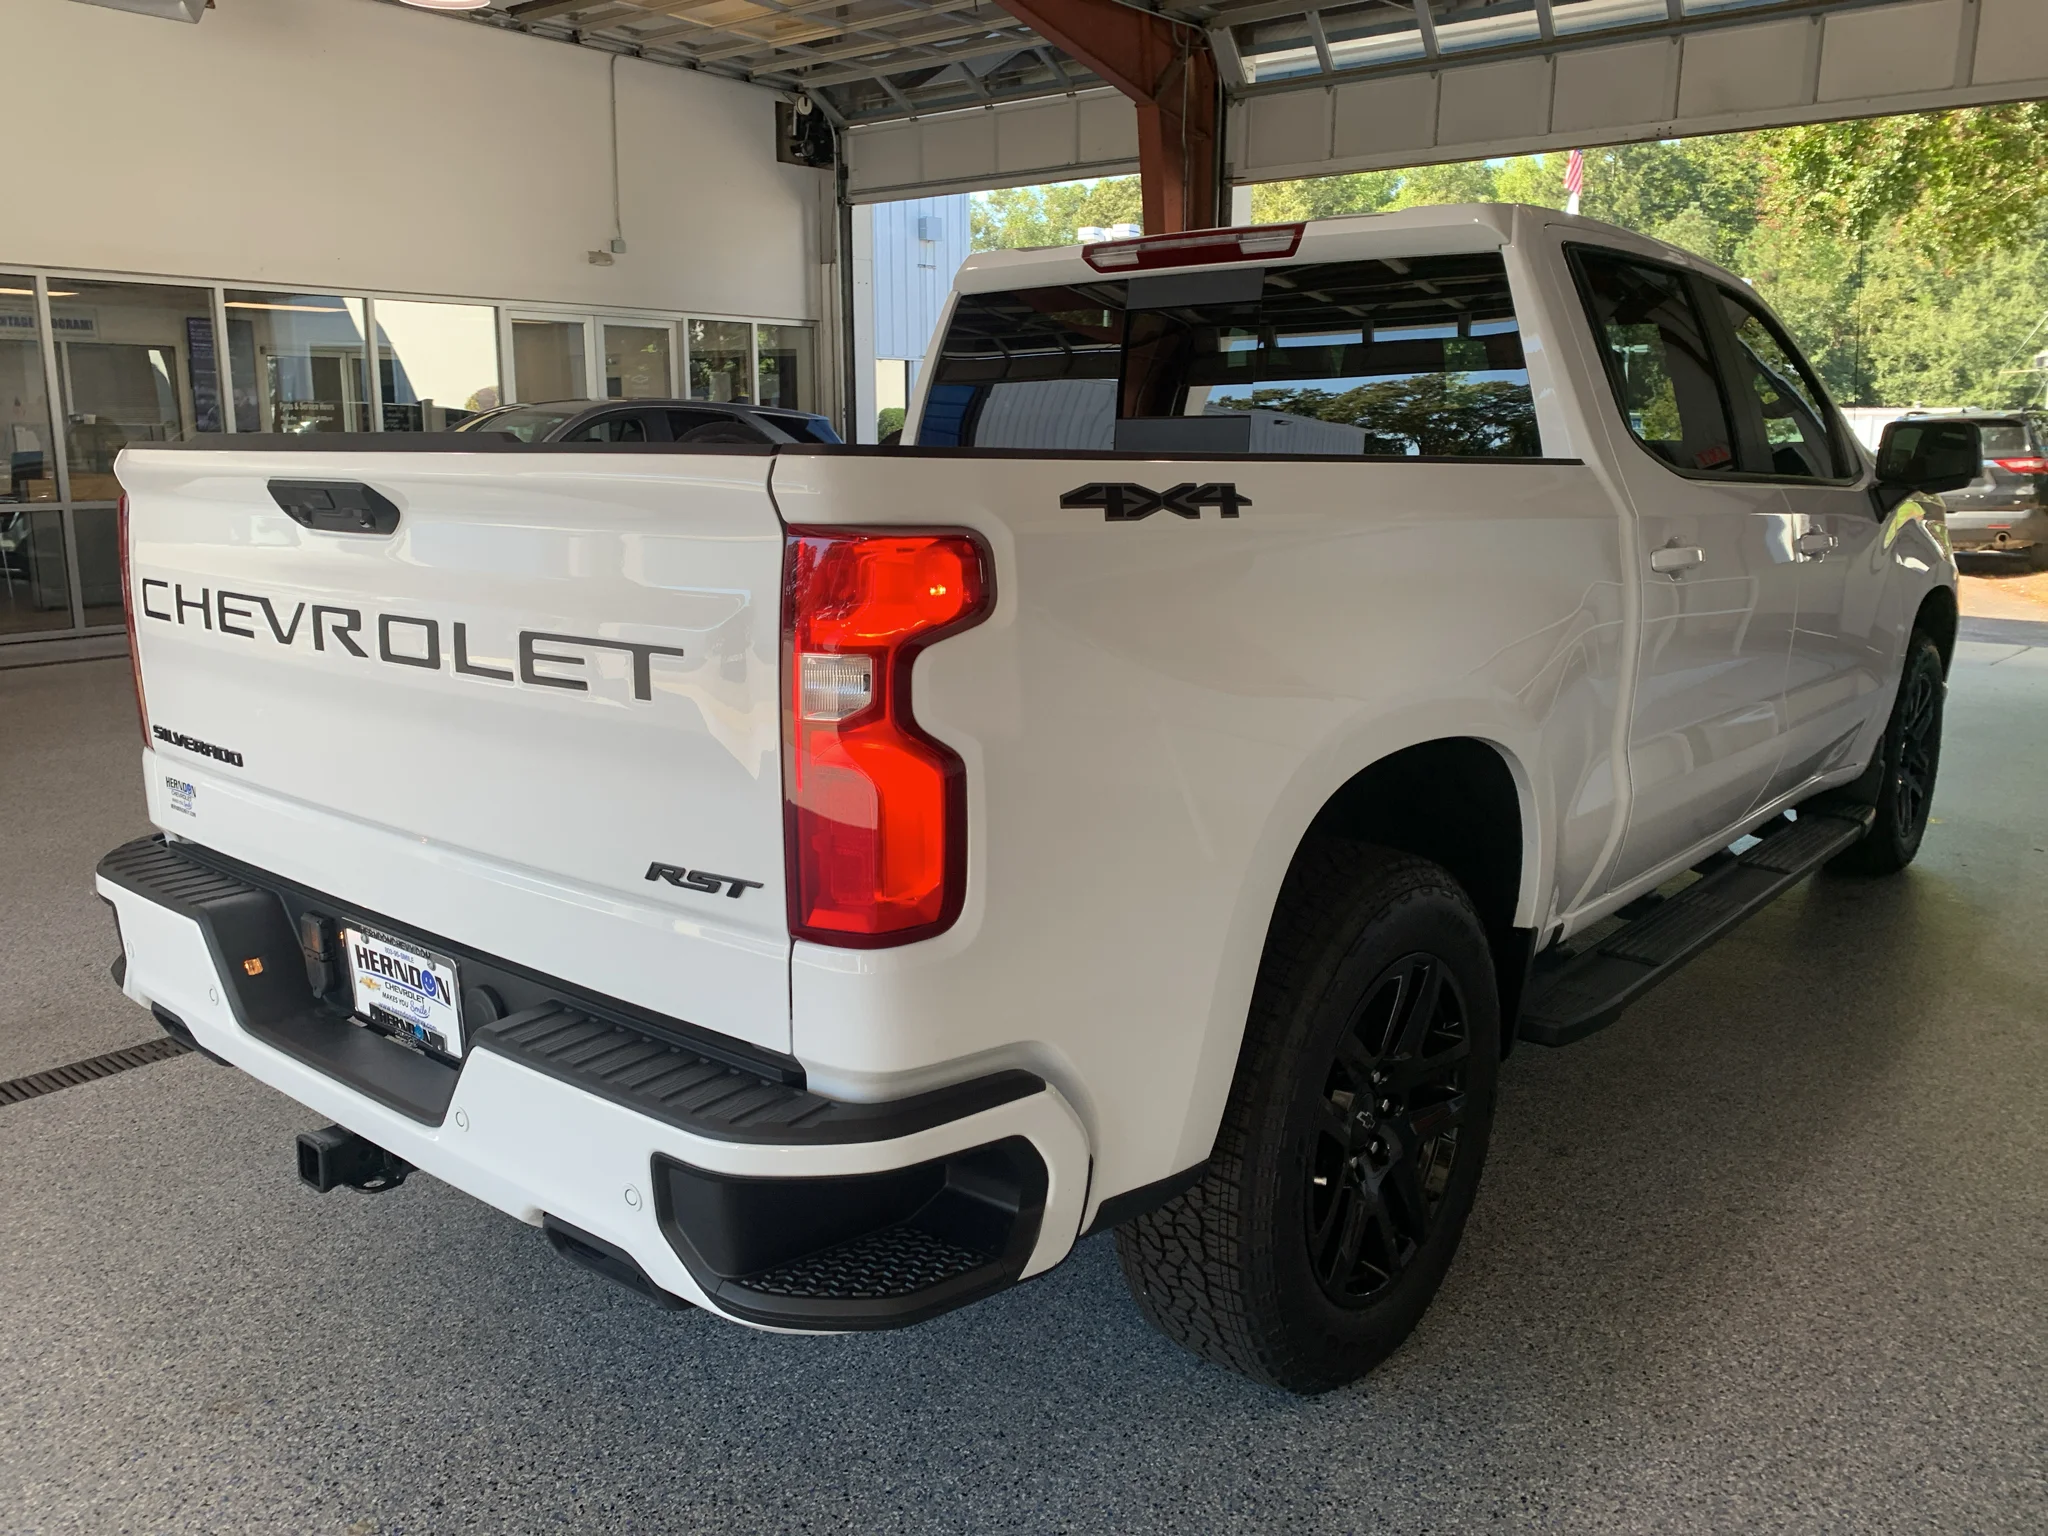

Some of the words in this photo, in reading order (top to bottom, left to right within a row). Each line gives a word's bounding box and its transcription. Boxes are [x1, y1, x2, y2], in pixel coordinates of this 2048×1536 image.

[142, 578, 684, 701] CHEVROLET
[153, 724, 243, 767] SILVERADO
[644, 861, 765, 899] RST
[354, 944, 451, 1006] HERNDON
[384, 981, 425, 1003] CHEVROLET
[382, 991, 398, 1004] MAKES
[399, 999, 409, 1008] YOU
